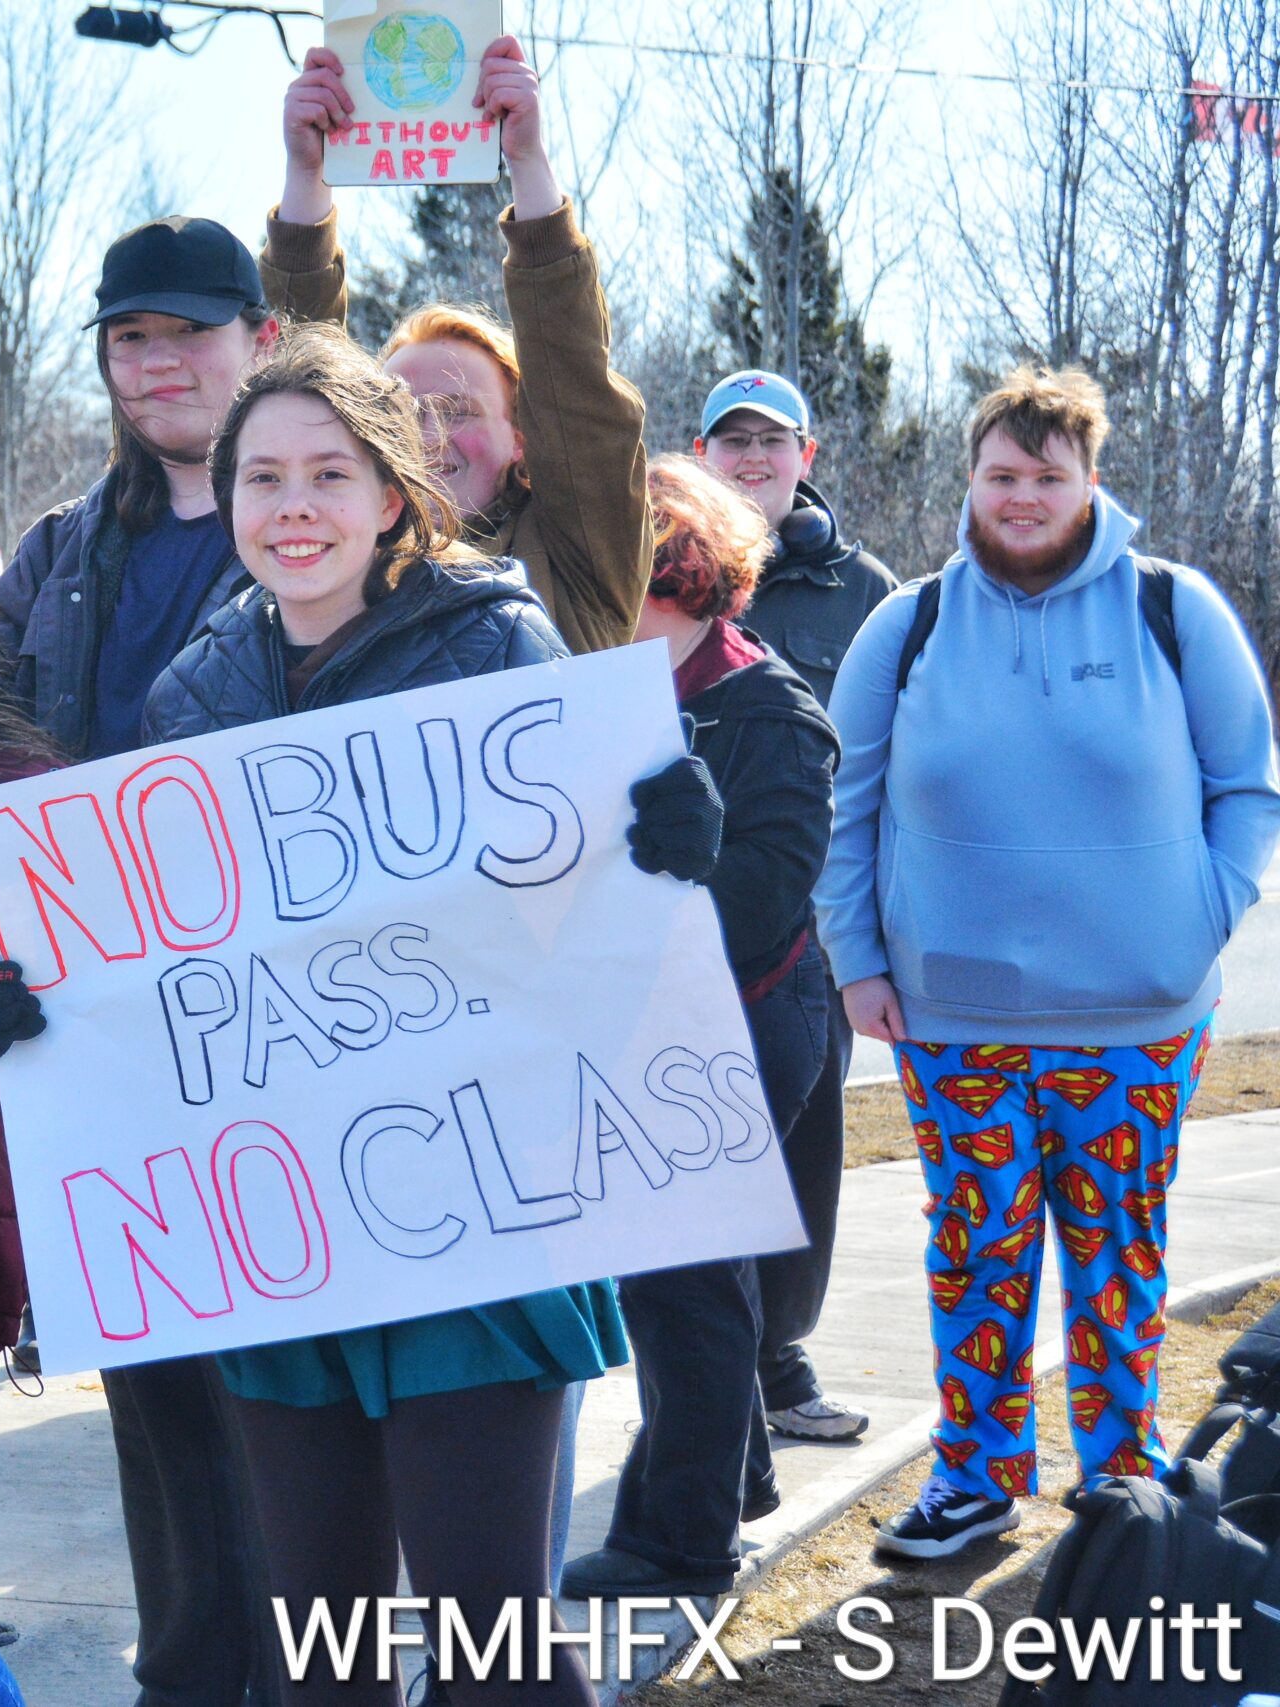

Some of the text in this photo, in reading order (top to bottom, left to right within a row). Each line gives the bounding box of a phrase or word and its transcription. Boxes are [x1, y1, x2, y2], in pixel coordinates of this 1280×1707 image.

[326, 120, 496, 146] WITHOUT
[369, 148, 456, 180] ART
[238, 698, 584, 922] BUS
[157, 922, 491, 1105] PASS.
[61, 1045, 774, 1340] NO CLASS
